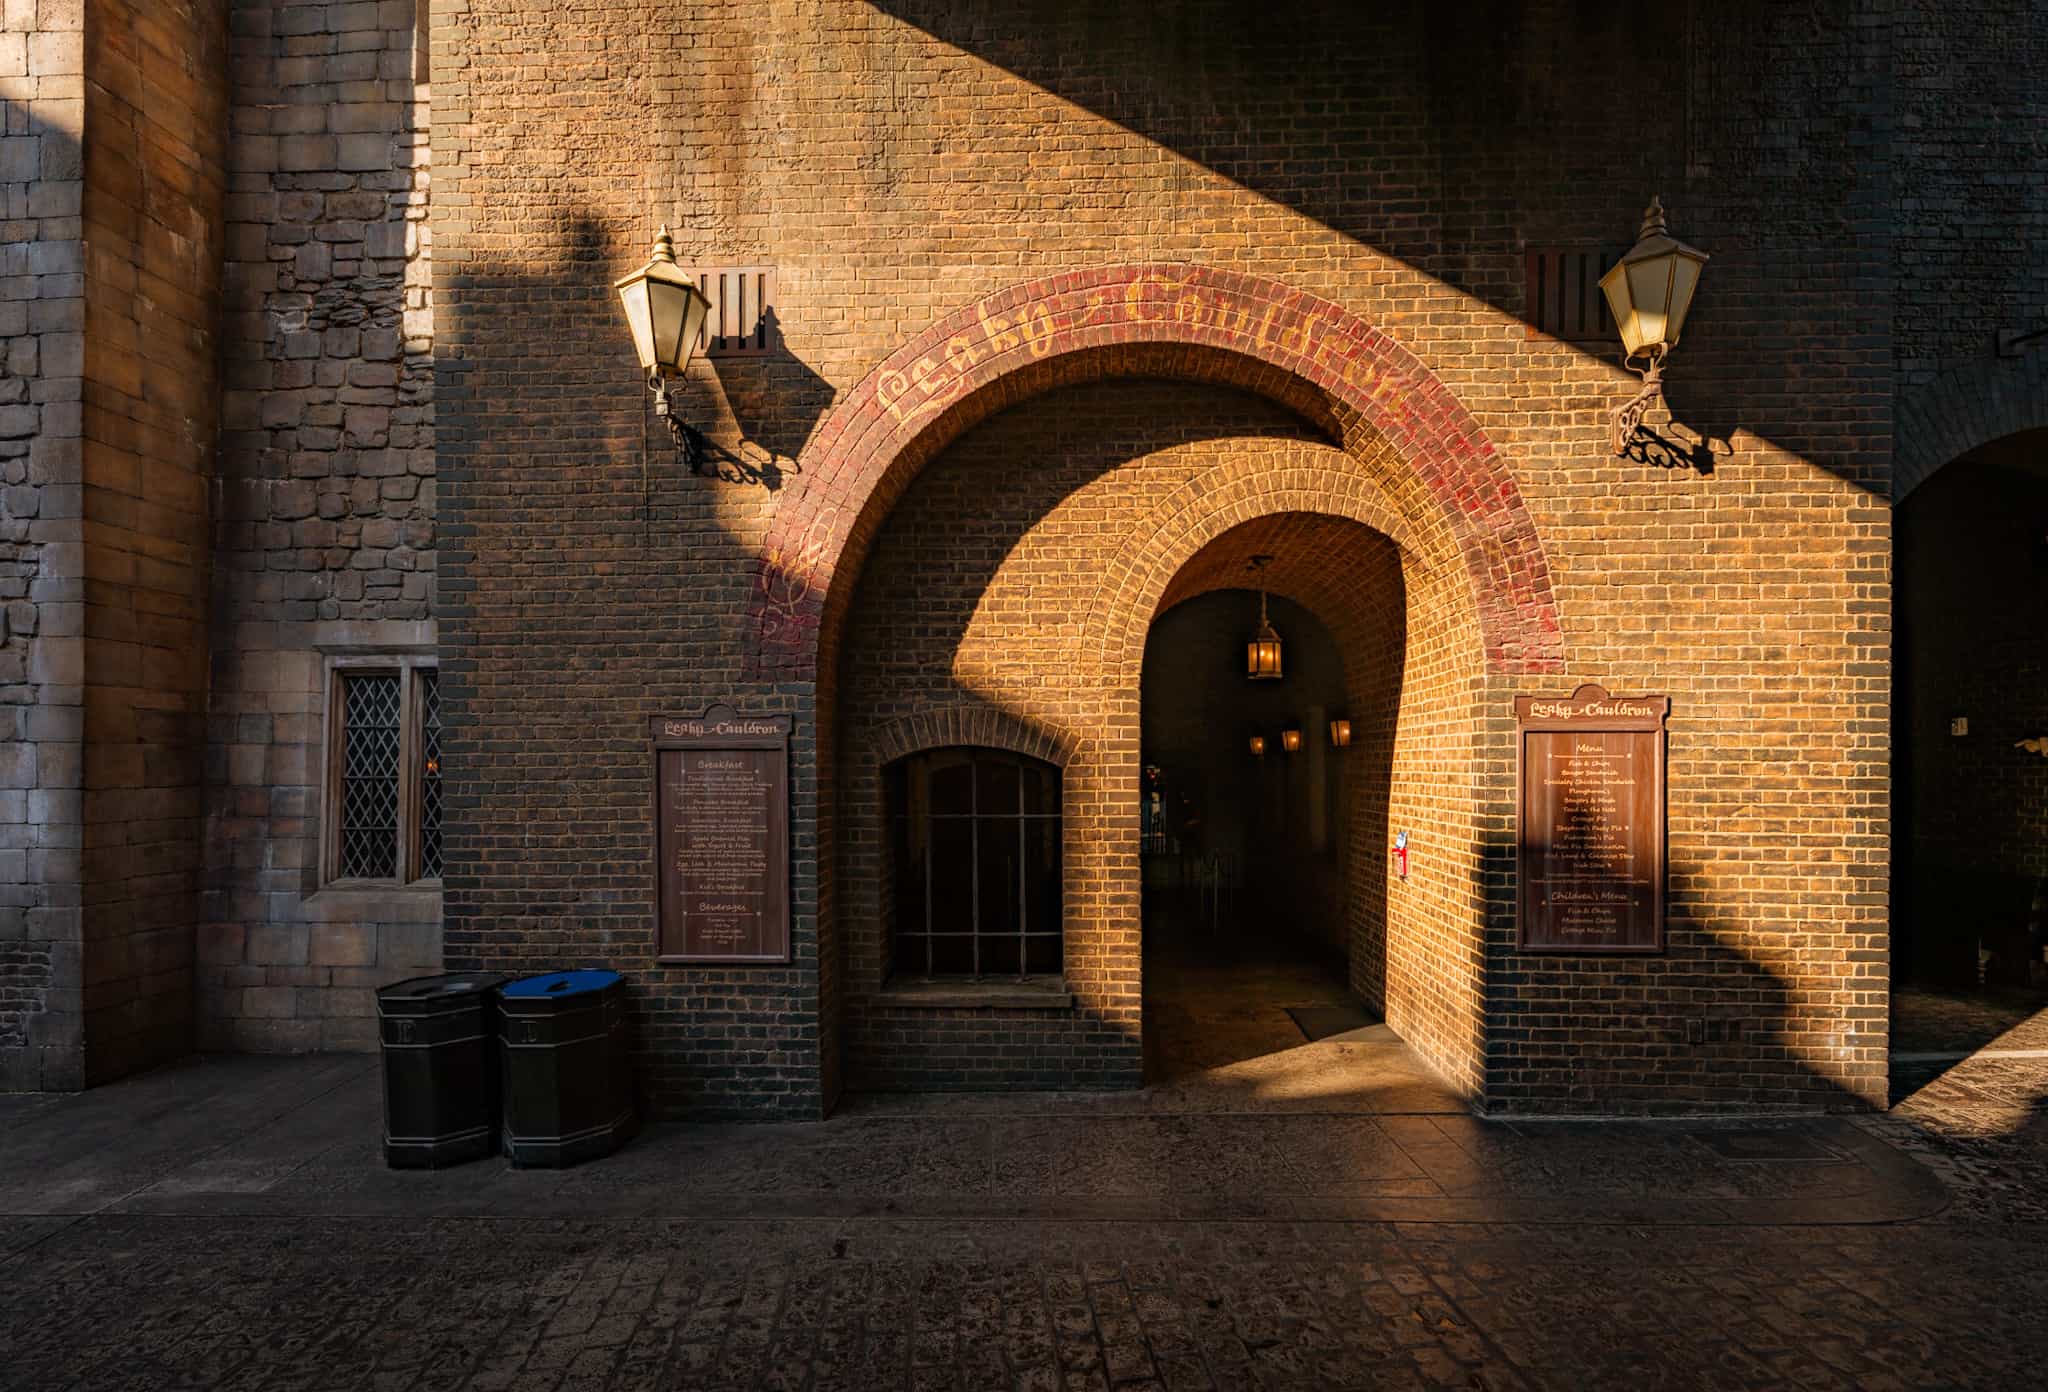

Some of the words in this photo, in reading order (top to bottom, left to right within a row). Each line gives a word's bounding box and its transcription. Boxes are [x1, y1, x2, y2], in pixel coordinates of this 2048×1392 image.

[876, 302, 1056, 421] Leaky
[1125, 272, 1409, 419] Cauldron
[1530, 702, 1573, 719] Leaky
[1585, 700, 1654, 717] Cauldron
[664, 721, 704, 737] Leaky
[716, 721, 778, 735] Cauldron
[1577, 744, 1604, 753] Menu
[698, 760, 744, 769] Breakfast
